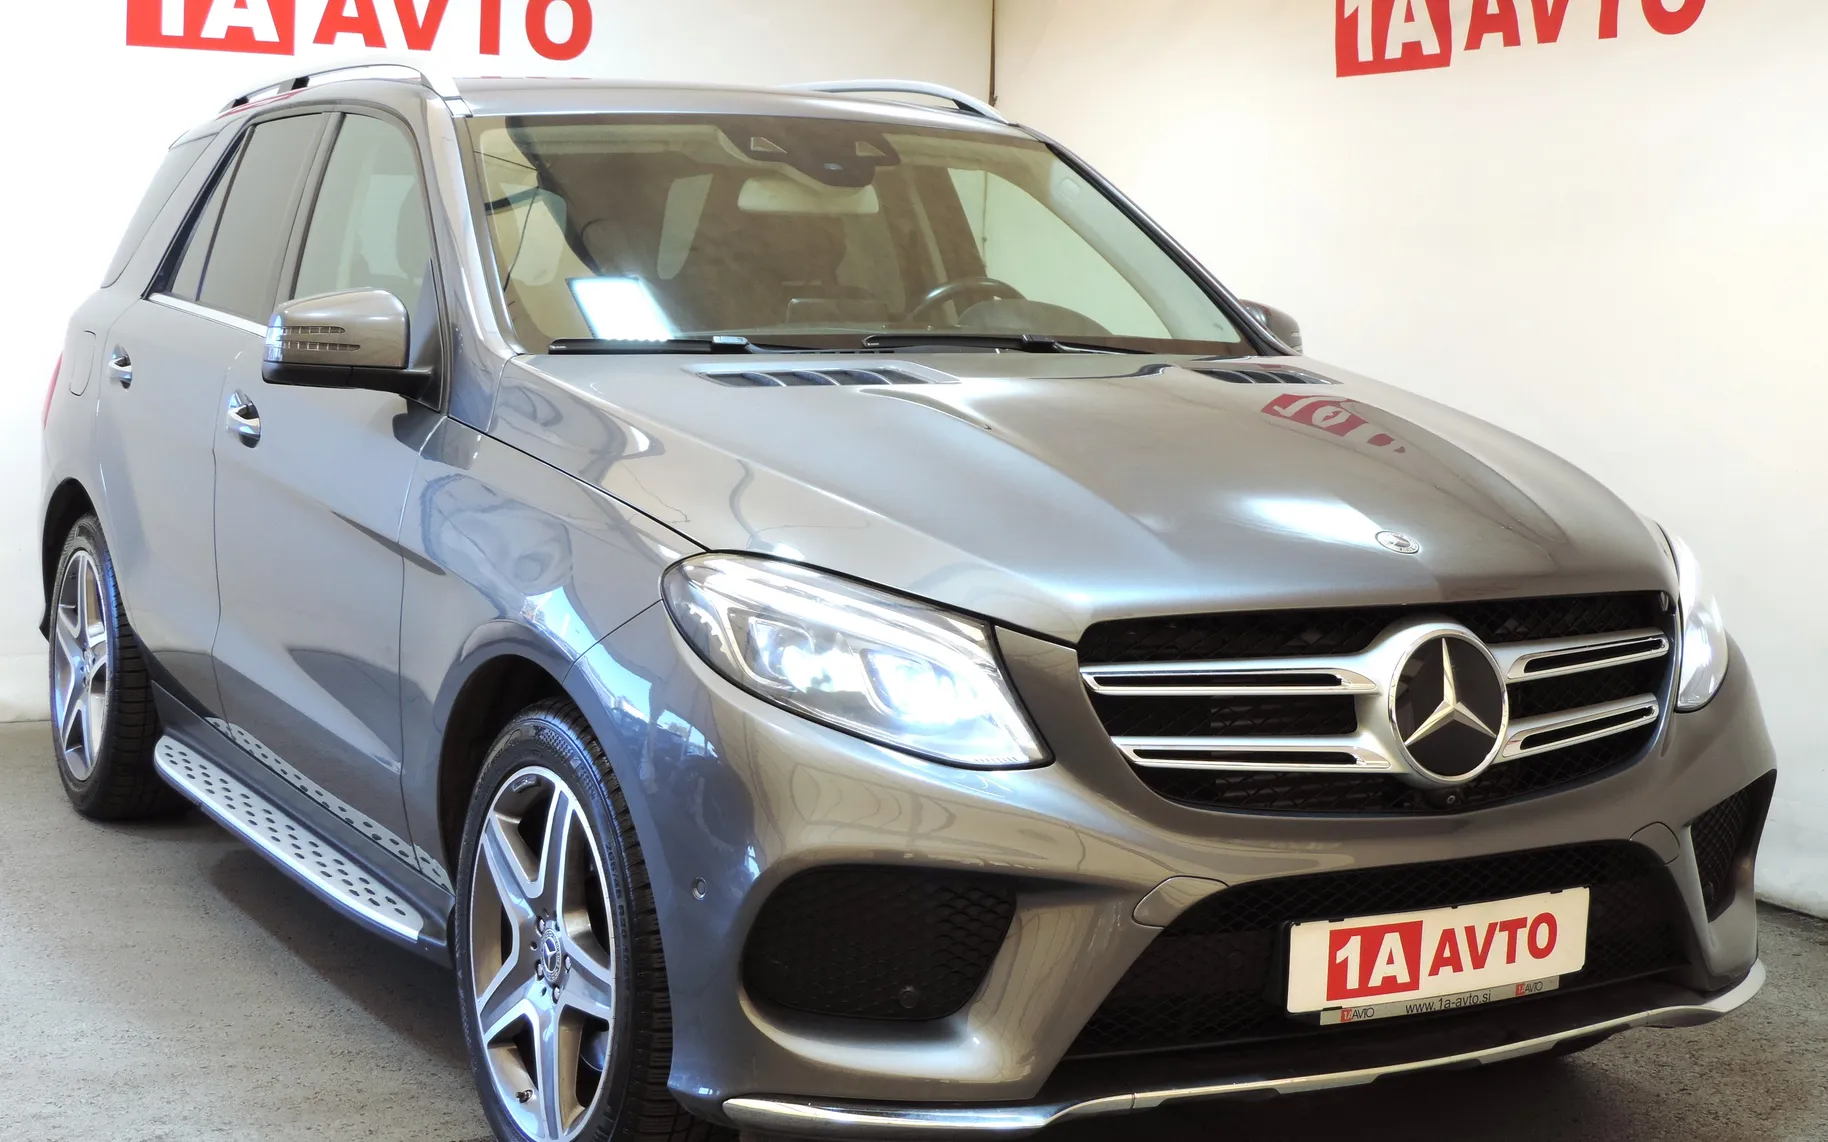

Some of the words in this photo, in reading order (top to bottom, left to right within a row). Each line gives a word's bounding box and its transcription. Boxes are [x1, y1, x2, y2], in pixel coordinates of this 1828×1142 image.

[1335, 932, 1411, 990] 1A
[1428, 912, 1558, 976] AVTO
[1525, 981, 1543, 993] AVTO
[1405, 989, 1492, 1014] www.1a-avto.si
[1352, 1007, 1375, 1019] AVTO
